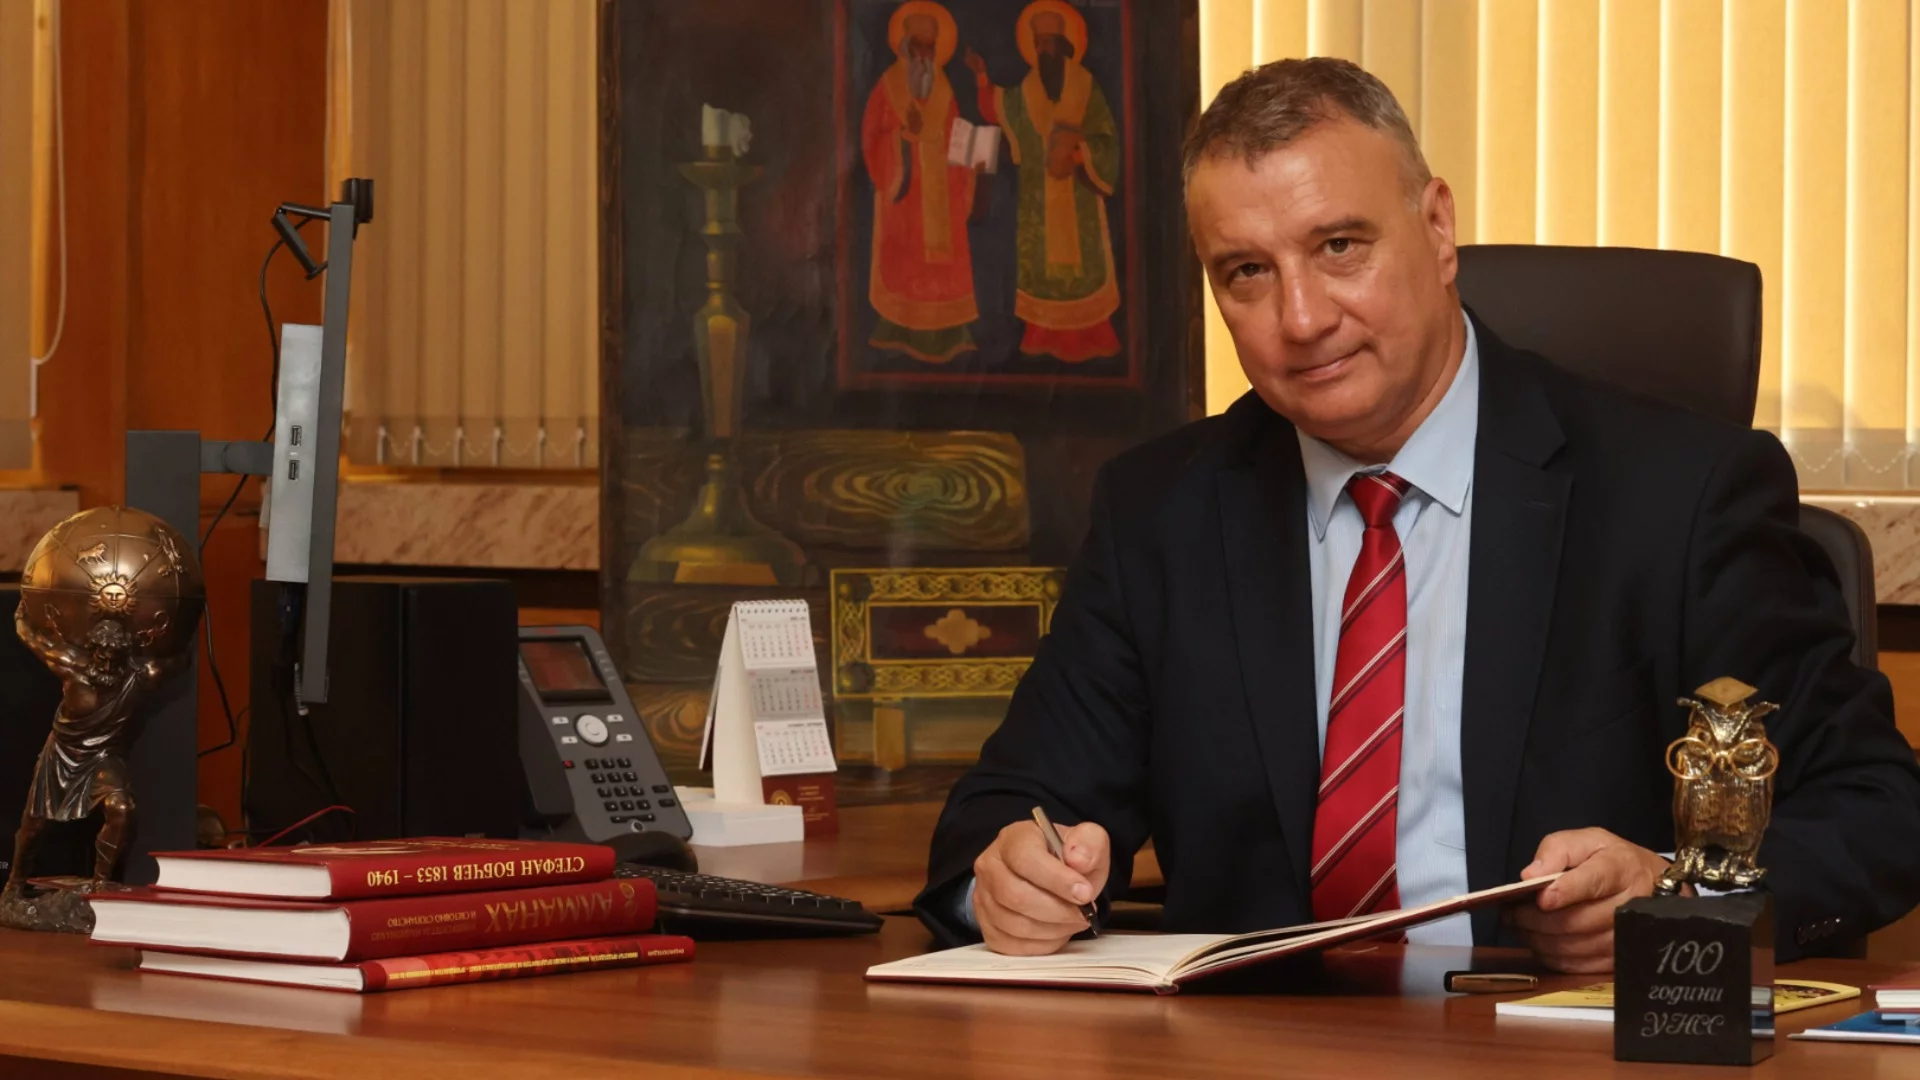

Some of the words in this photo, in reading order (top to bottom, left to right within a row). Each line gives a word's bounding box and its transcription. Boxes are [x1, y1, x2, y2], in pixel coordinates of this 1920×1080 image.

[416, 865, 448, 883] 1853
[453, 860, 515, 881] БОБЧЕВ
[521, 856, 585, 876] СТЕФАН
[366, 869, 400, 887] 1940
[484, 890, 613, 934] АЛМАНАХ
[1657, 940, 1724, 976] 100
[1648, 984, 1724, 1005] години
[1641, 1011, 1724, 1038] УНСС
